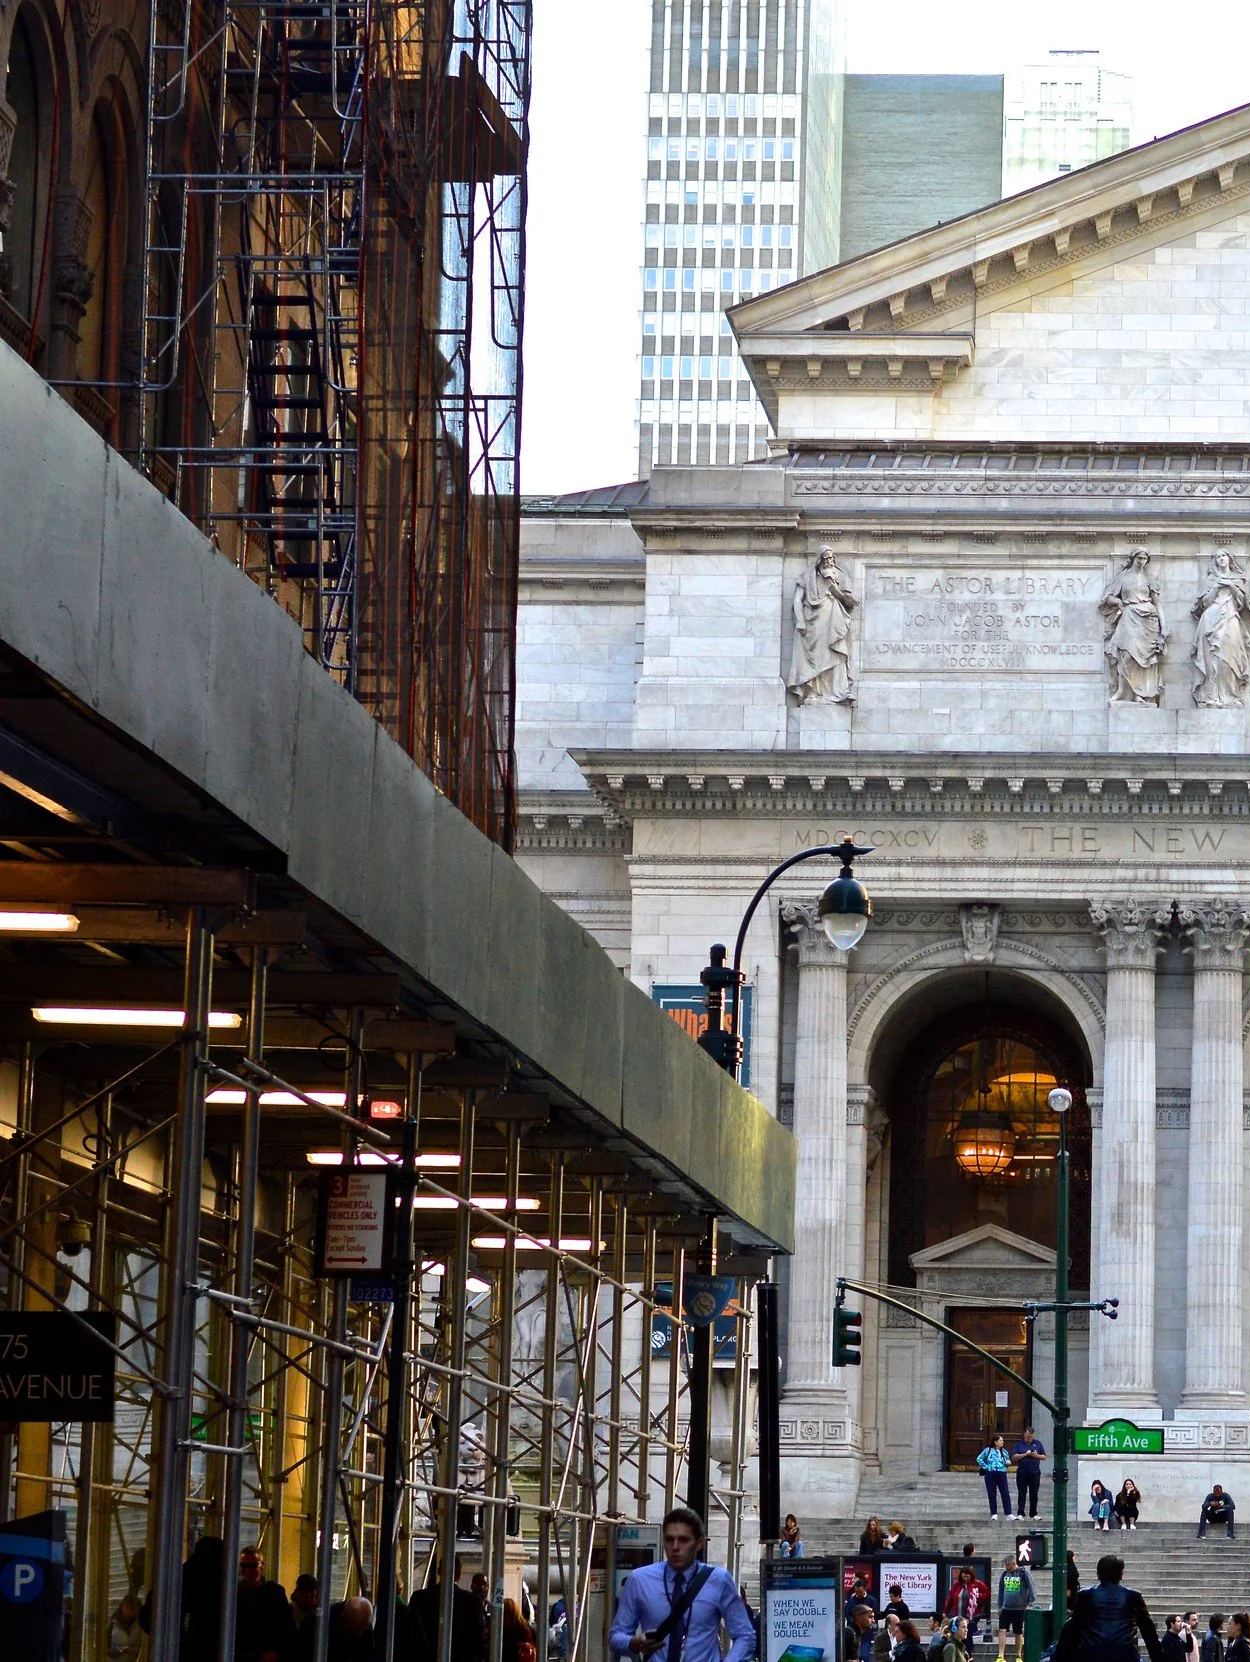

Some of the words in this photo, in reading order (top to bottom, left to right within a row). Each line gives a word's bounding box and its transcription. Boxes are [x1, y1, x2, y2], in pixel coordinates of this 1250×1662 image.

[879, 577, 916, 594] THE
[931, 577, 994, 594] ASTOR
[1006, 577, 1092, 595] LIBRARY
[940, 603, 998, 613] FOUNDED
[1012, 603, 1026, 613] BY
[905, 614, 946, 628] JOHN
[954, 614, 1004, 628] JACOB
[1015, 615, 1062, 628] ASTOR
[954, 630, 977, 641] FOR
[986, 630, 1009, 641] THE
[874, 644, 958, 655] ADVANCEMENT
[962, 644, 977, 655] OF
[983, 644, 1024, 655] USEFUL
[1026, 645, 1095, 655] KNOWLEDGE
[1020, 826, 1101, 854] THE
[1131, 827, 1227, 855] NEW
[333, 1176, 343, 1194] 3
[329, 1200, 374, 1209] COMMERCIAL
[328, 1211, 360, 1220] VEHICLES
[361, 1211, 378, 1220] ONLY
[0, 1334, 28, 1359] 75
[1088, 1434, 1119, 1449] Fifth
[1122, 1435, 1150, 1449] Ave
[14, 1563, 36, 1597] P
[907, 1582, 933, 1591] Library
[773, 1599, 800, 1608] WHEN
[802, 1599, 815, 1607] WE
[773, 1608, 791, 1617] SAY
[792, 1607, 828, 1616] DOUBLE
[773, 1620, 787, 1629] WE
[789, 1620, 814, 1629] MEAN
[773, 1629, 811, 1638] DOUBLE.
